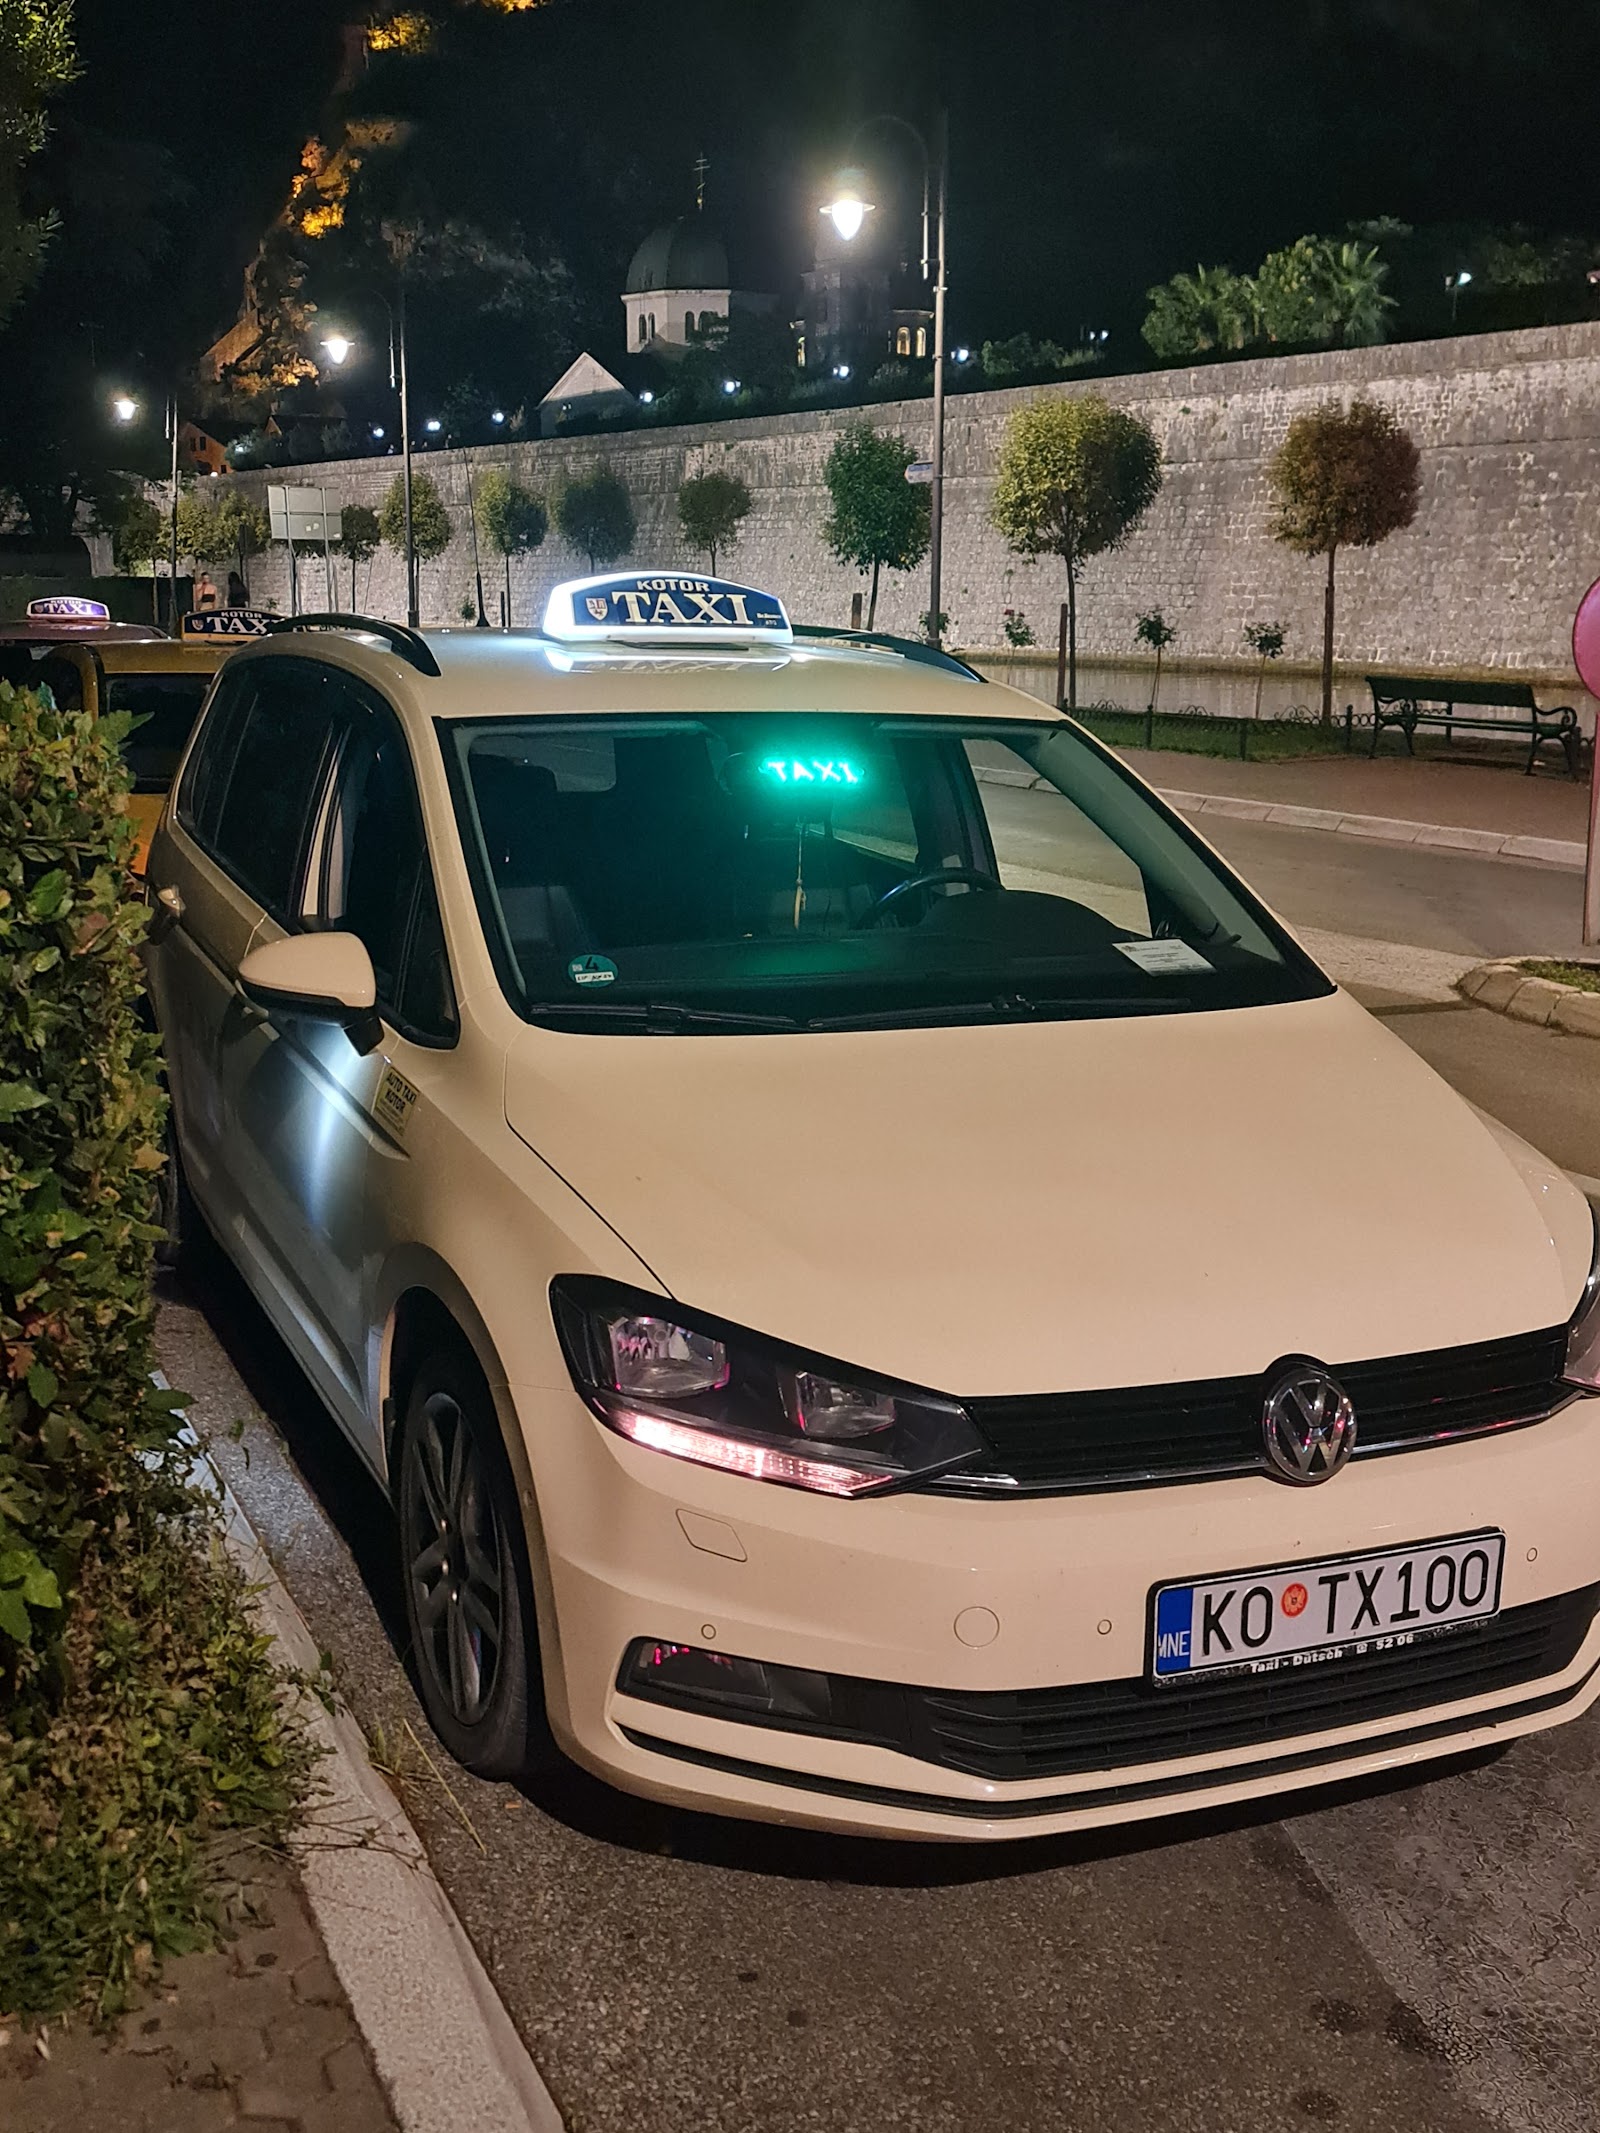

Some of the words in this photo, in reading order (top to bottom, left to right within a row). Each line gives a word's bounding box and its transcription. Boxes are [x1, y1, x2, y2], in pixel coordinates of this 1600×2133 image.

[636, 579, 710, 592] KOTOR
[44, 603, 94, 615] TAXI
[221, 611, 263, 619] KOTOR
[612, 591, 754, 625] TAXI
[206, 616, 284, 635] TAX
[767, 761, 858, 783] TAXI
[585, 956, 599, 971] 4
[386, 1072, 403, 1092] AUTO
[385, 1089, 406, 1114] KOTOR
[1202, 1586, 1274, 1657] KO
[1318, 1549, 1489, 1634] TX100
[1158, 1630, 1191, 1658] MNE
[1250, 1660, 1279, 1674] Taxi
